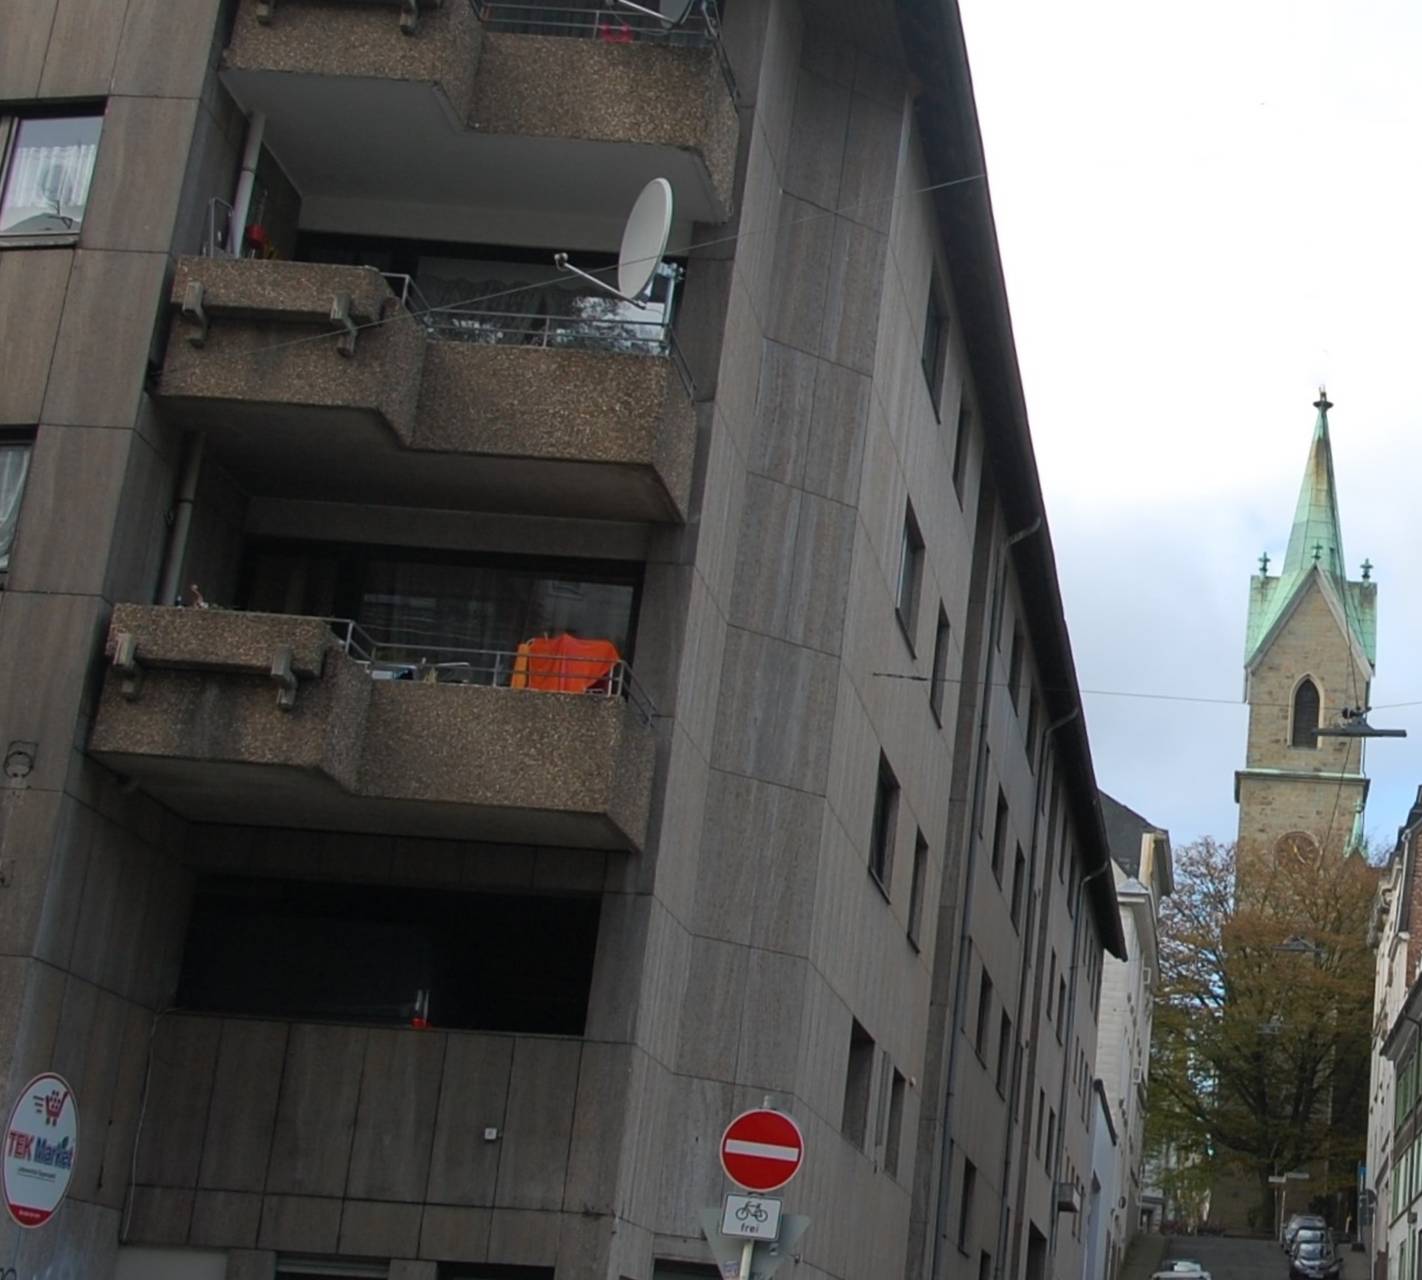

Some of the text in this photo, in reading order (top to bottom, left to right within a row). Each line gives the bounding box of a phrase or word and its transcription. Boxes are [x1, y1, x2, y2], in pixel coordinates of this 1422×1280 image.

[8, 1130, 73, 1169] TEK Market
[740, 1223, 760, 1234] frei
